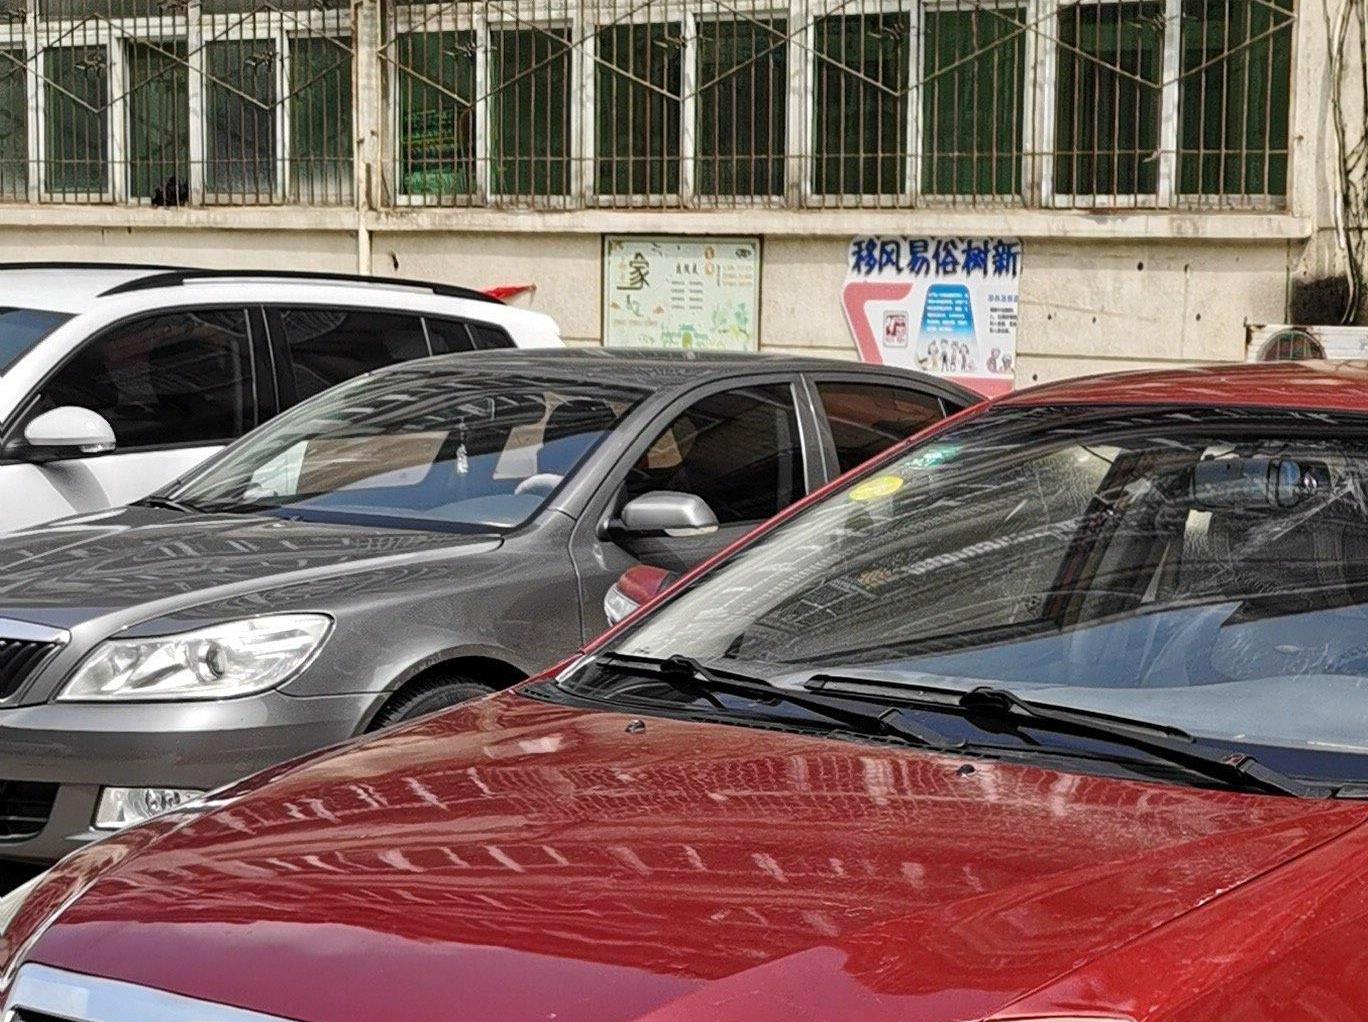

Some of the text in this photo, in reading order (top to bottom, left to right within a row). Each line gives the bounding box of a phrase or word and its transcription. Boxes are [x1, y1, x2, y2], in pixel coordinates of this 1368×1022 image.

[852, 239, 1020, 280] 移风易俗树新
